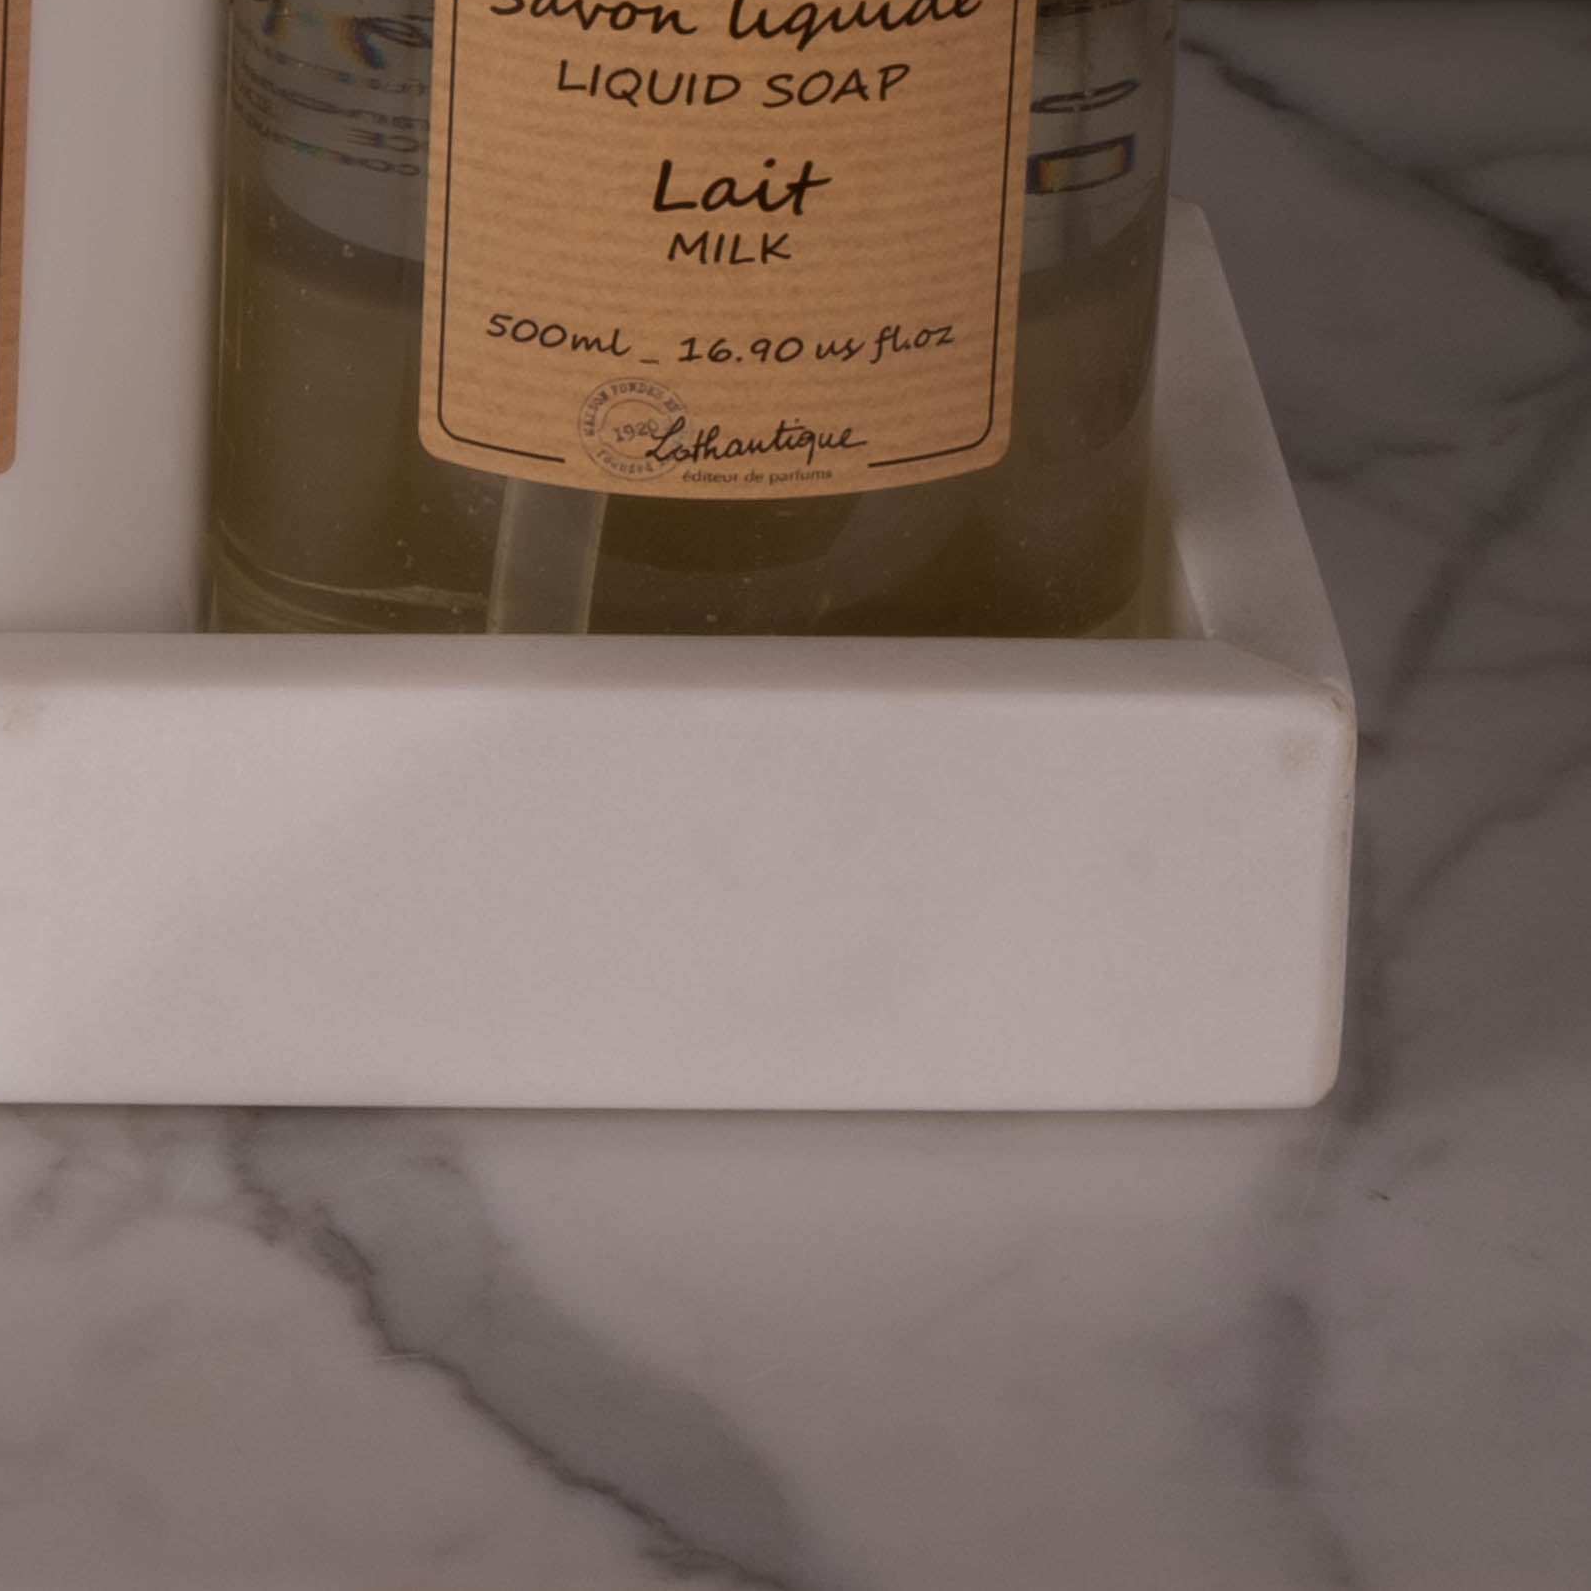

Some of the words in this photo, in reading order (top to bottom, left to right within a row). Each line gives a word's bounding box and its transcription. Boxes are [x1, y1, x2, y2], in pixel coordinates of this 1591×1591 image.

[558, 59, 741, 108] LIQUID
[762, 63, 910, 109] SOAP
[652, 158, 833, 216] Lait
[667, 230, 791, 265] MILK
[485, 312, 632, 357] 500ml
[678, 336, 805, 364] 16.90
[816, 337, 864, 362] us
[612, 419, 659, 442] 1920
[645, 416, 868, 464] Lothantique
[682, 469, 738, 483] éditeur
[744, 469, 763, 483] de
[769, 469, 833, 486] parfums
